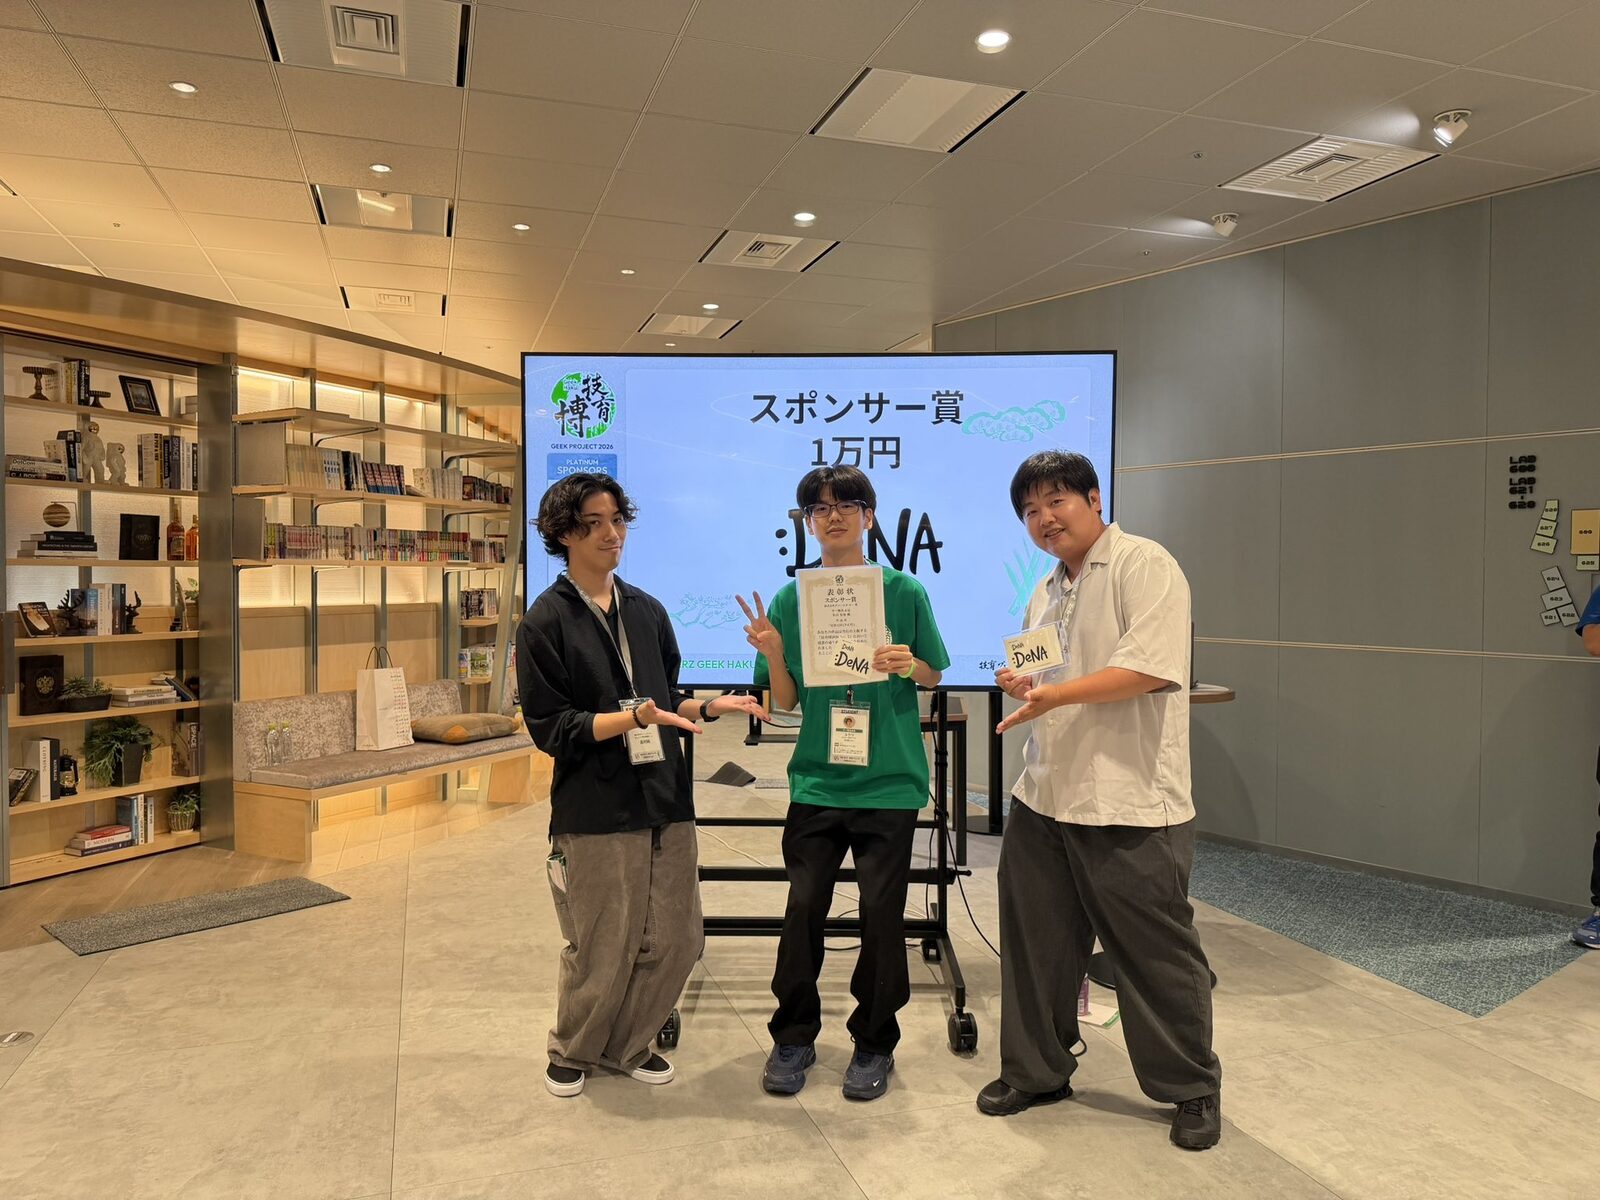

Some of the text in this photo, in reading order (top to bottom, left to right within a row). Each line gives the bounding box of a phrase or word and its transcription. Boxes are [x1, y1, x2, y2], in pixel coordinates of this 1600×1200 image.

[750, 389, 964, 425] スポンサー賞
[811, 436, 900, 469] 1万円
[557, 466, 608, 474] SPONSORS
[1509, 477, 1537, 486] LAB
[697, 660, 725, 669] GEEK
[834, 651, 870, 675] :DeNA
[1012, 646, 1049, 669] :DeNA
[190, 725, 198, 749] SPACE
